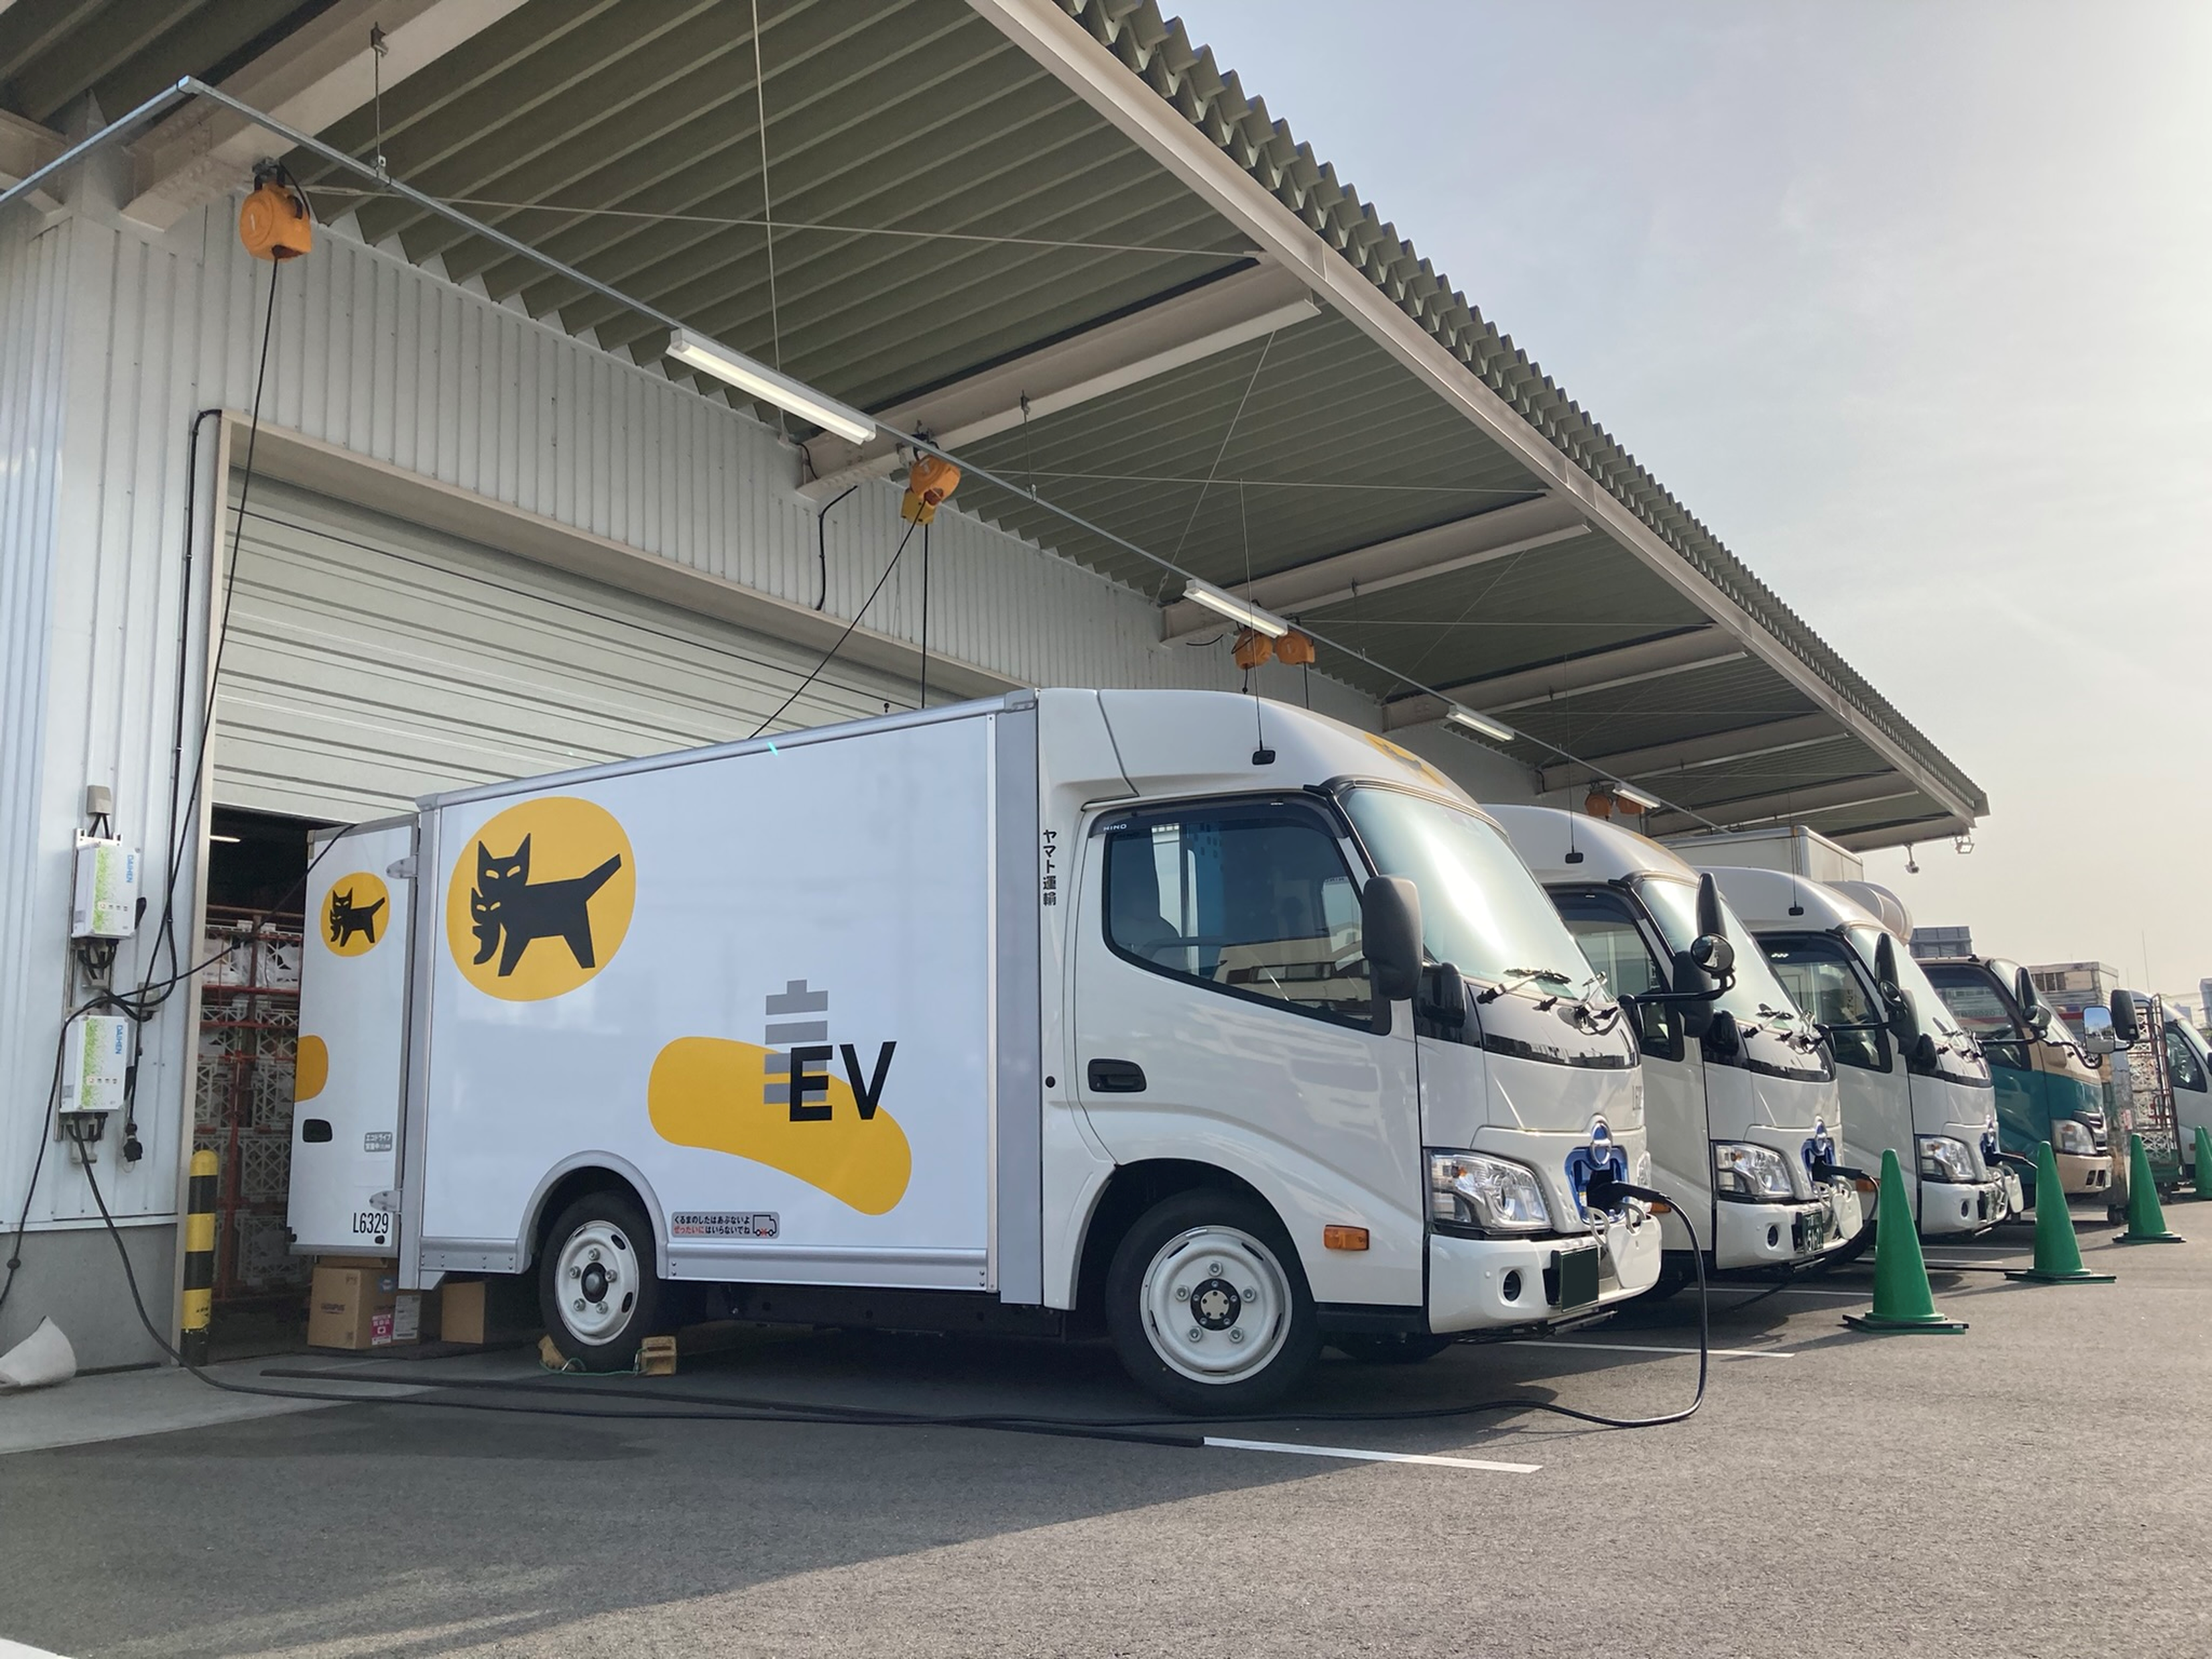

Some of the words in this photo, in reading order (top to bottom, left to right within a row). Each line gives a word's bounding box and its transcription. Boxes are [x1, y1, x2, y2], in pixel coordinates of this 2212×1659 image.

[126, 855, 134, 883] DAIHEN
[1043, 829, 1057, 906] ヤマト運輸
[115, 1025, 123, 1054] DAIHEN
[790, 1041, 897, 1121] EV
[353, 1213, 389, 1233] L6329
[674, 1215, 750, 1225] くるまのしたはあぶないよ
[674, 1225, 751, 1235] ぜったいにはいらないでね
